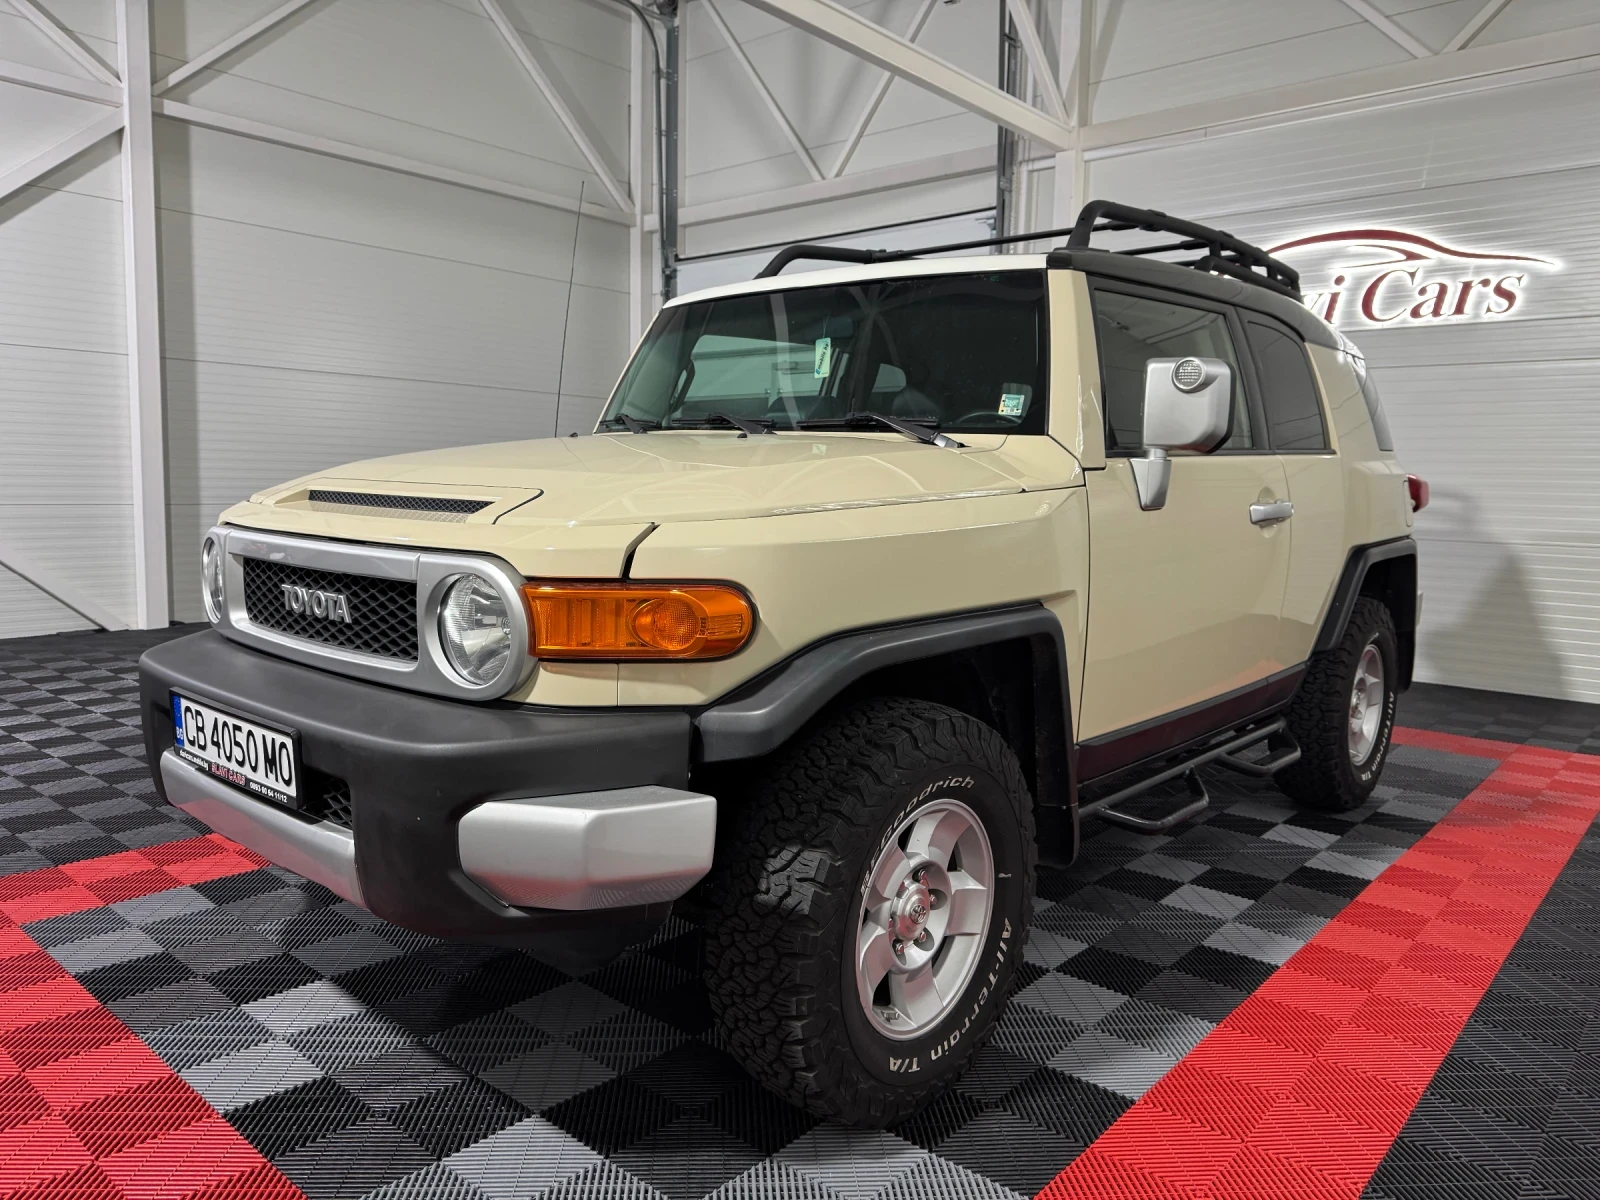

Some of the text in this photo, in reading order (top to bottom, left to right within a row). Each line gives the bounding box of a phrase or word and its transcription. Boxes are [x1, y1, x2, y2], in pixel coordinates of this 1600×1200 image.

[1361, 267, 1525, 323] Cars
[281, 584, 352, 623] TOYOTA
[184, 705, 207, 751] CB
[211, 716, 258, 773] 4050
[262, 733, 293, 786] MO
[930, 917, 1012, 1061] All-Terrain
[889, 1057, 920, 1074] T/A
